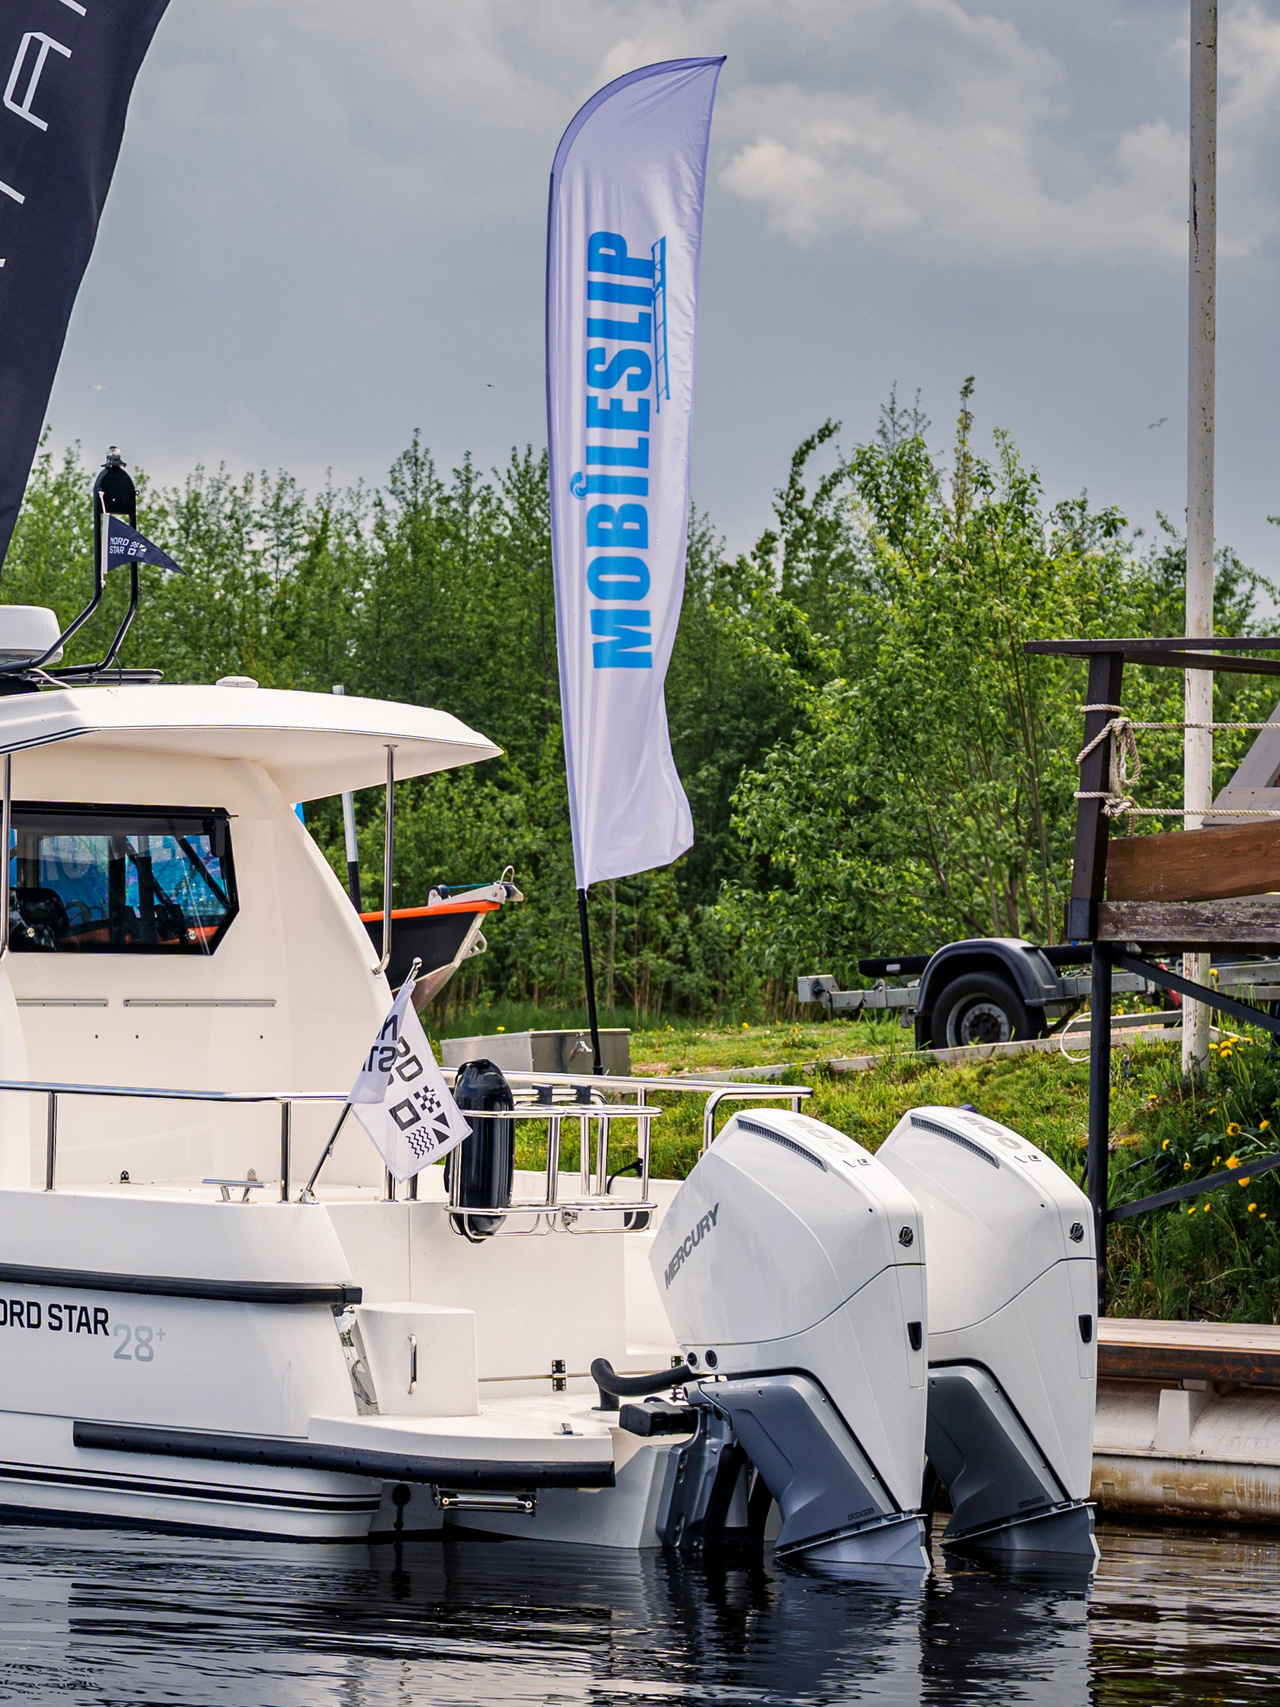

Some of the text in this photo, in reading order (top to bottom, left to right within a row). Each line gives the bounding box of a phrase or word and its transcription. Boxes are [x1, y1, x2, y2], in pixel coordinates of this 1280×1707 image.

[572, 230, 654, 669] MOBILESLIP
[664, 1202, 719, 1290] MERCURY
[47, 1303, 110, 1336] STAR
